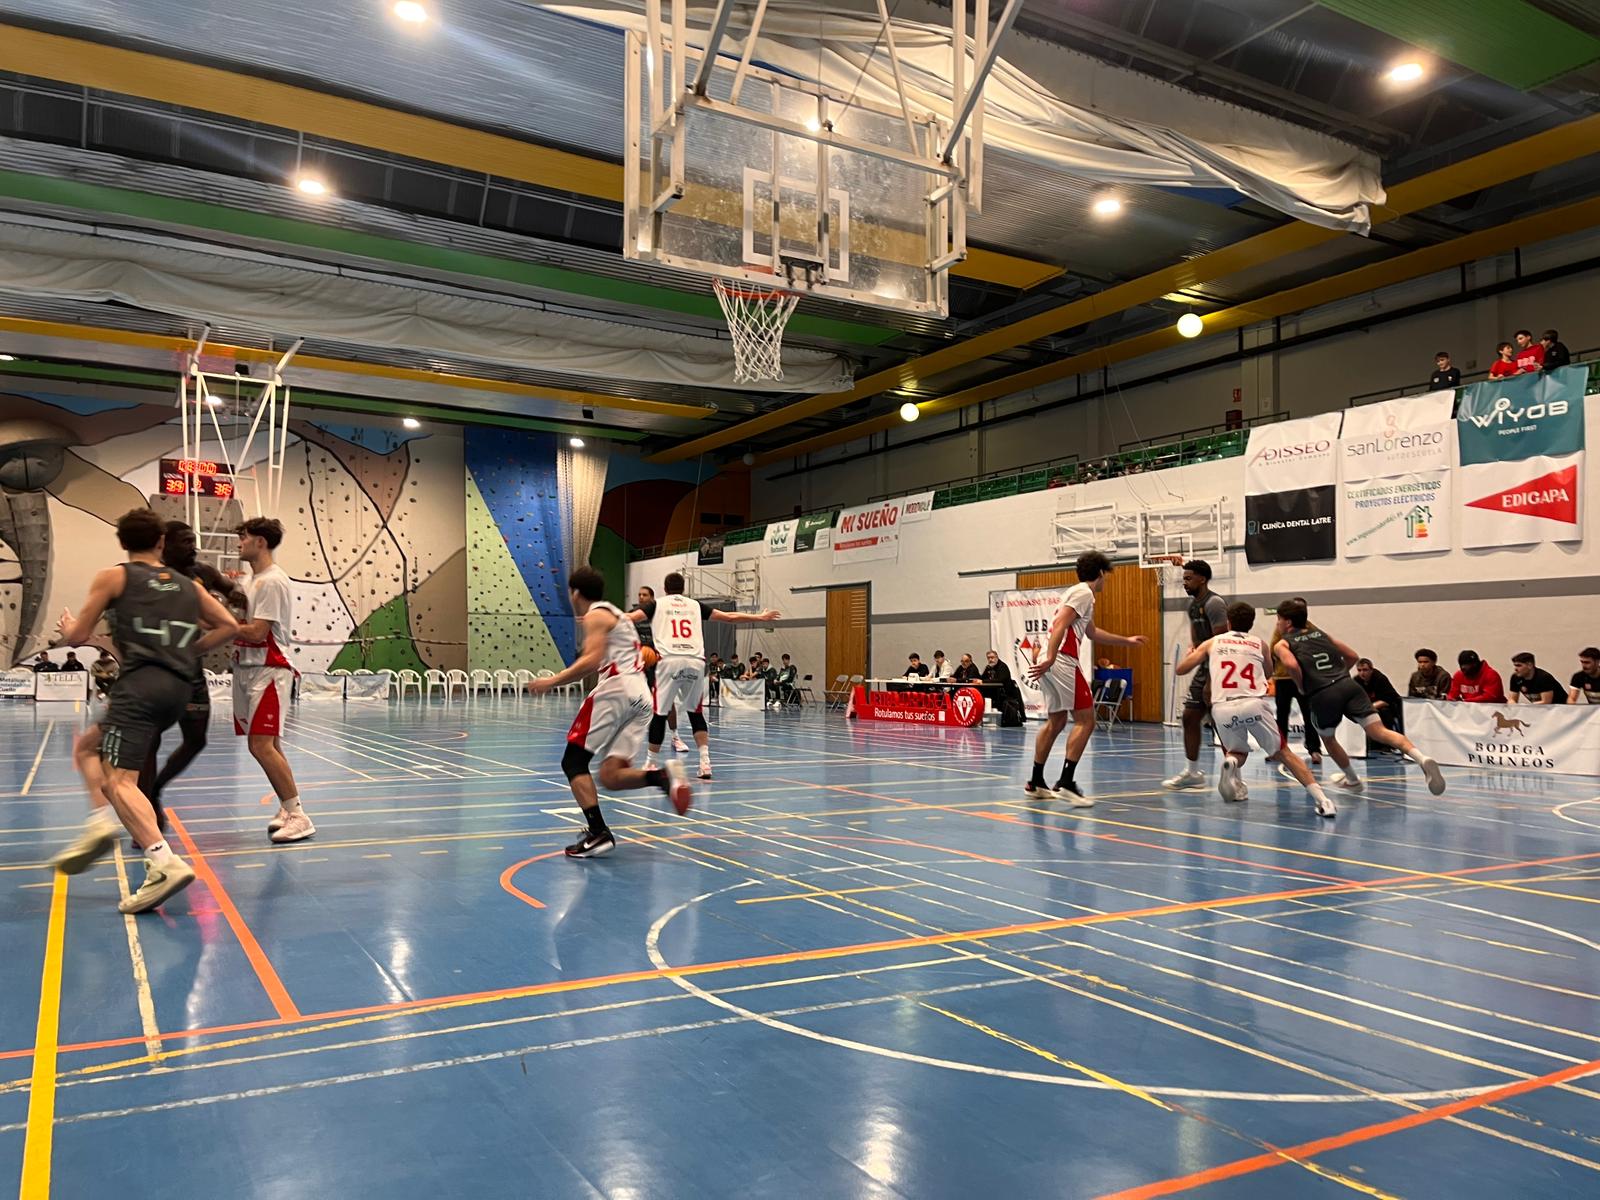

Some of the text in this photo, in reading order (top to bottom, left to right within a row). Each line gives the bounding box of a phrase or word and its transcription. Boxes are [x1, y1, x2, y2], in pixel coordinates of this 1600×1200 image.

[1498, 424, 1537, 436] PEOPLE FIRST
[1248, 440, 1330, 467] ADISSEO
[1502, 488, 1569, 508] EDIGAPA
[841, 514, 856, 534] MI
[856, 503, 899, 531] SUEÑO
[1286, 519, 1310, 528] DENTAL
[1311, 516, 1332, 526] LATRE
[132, 616, 198, 649] 47
[671, 619, 692, 639] 16
[1312, 652, 1333, 671] 2
[1220, 660, 1257, 690] 24
[874, 707, 904, 719] Rotulamos
[904, 710, 914, 720] tus
[1475, 742, 1545, 755] BODEGA
[1468, 753, 1554, 768] PIRINEOS
